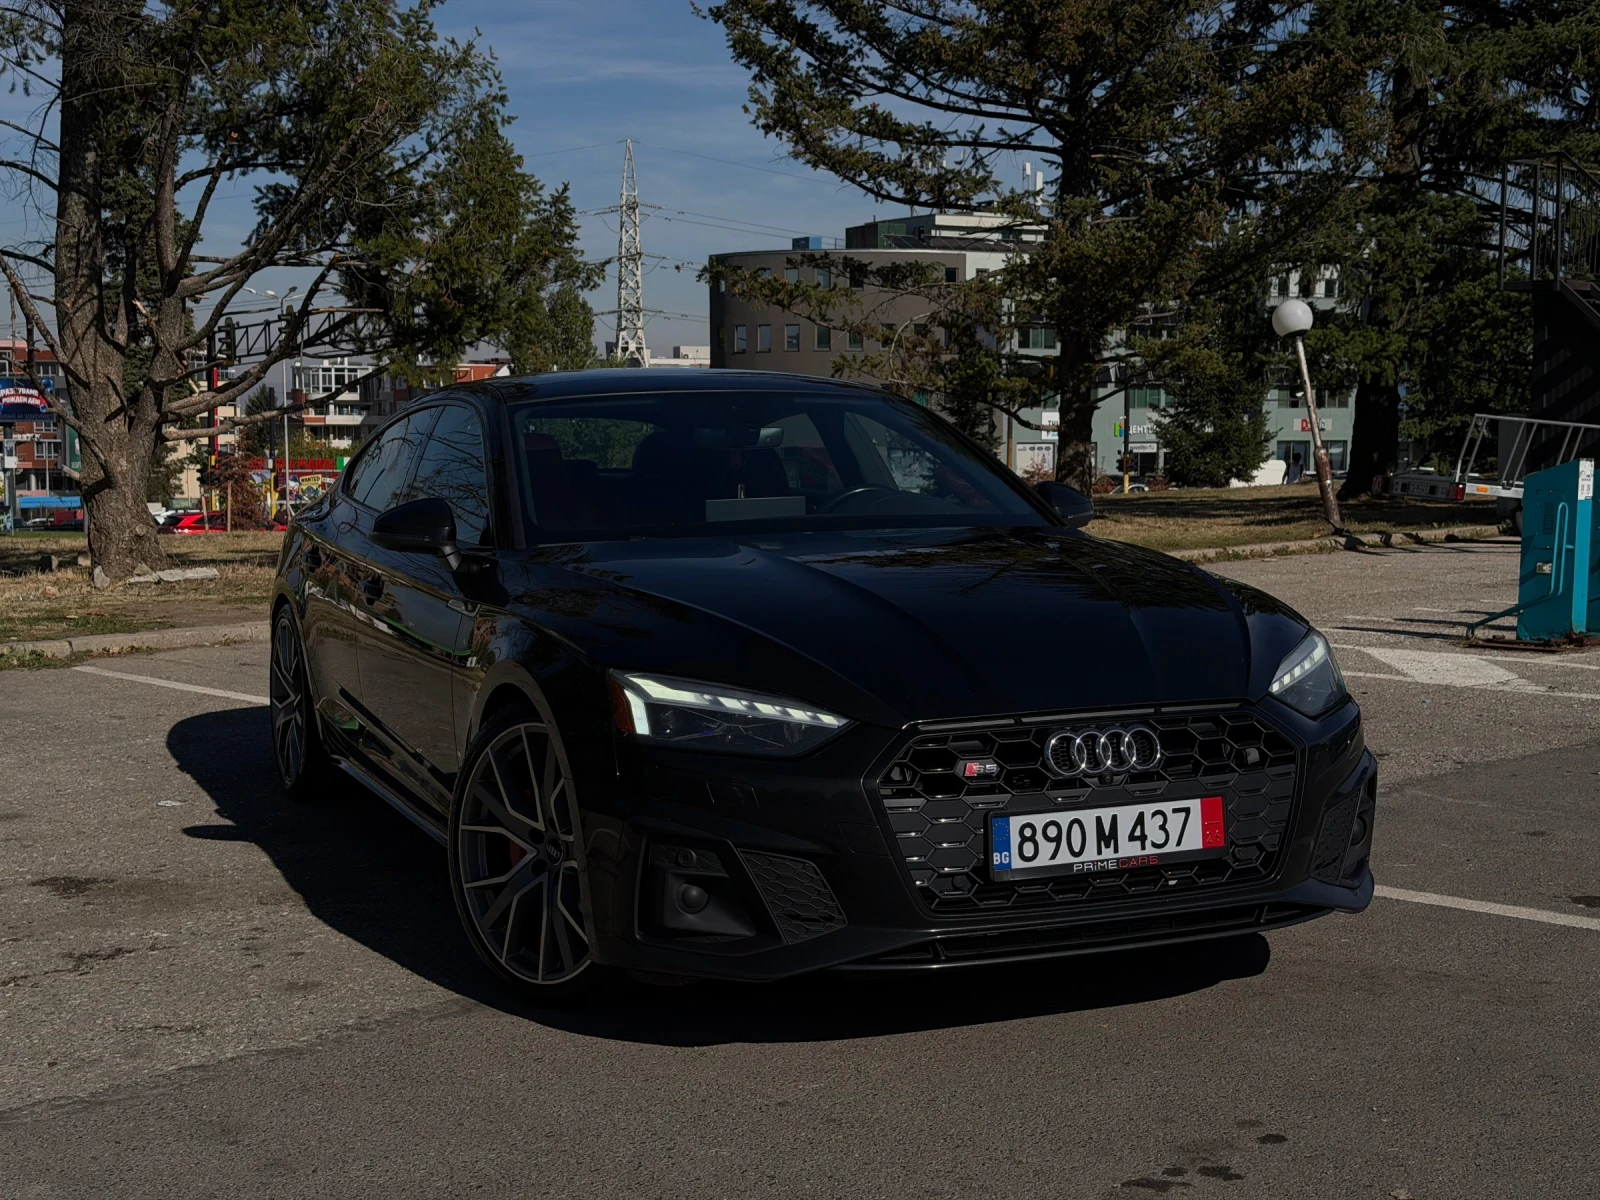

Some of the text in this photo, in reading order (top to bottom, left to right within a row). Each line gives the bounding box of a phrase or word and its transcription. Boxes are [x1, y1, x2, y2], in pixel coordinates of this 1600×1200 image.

[0, 387, 39, 397] РАЗУВАМЕ
[301, 475, 320, 483] WANTED
[969, 763, 998, 776] S5
[1017, 807, 1191, 862] 890 M 437
[993, 852, 1010, 865] BG
